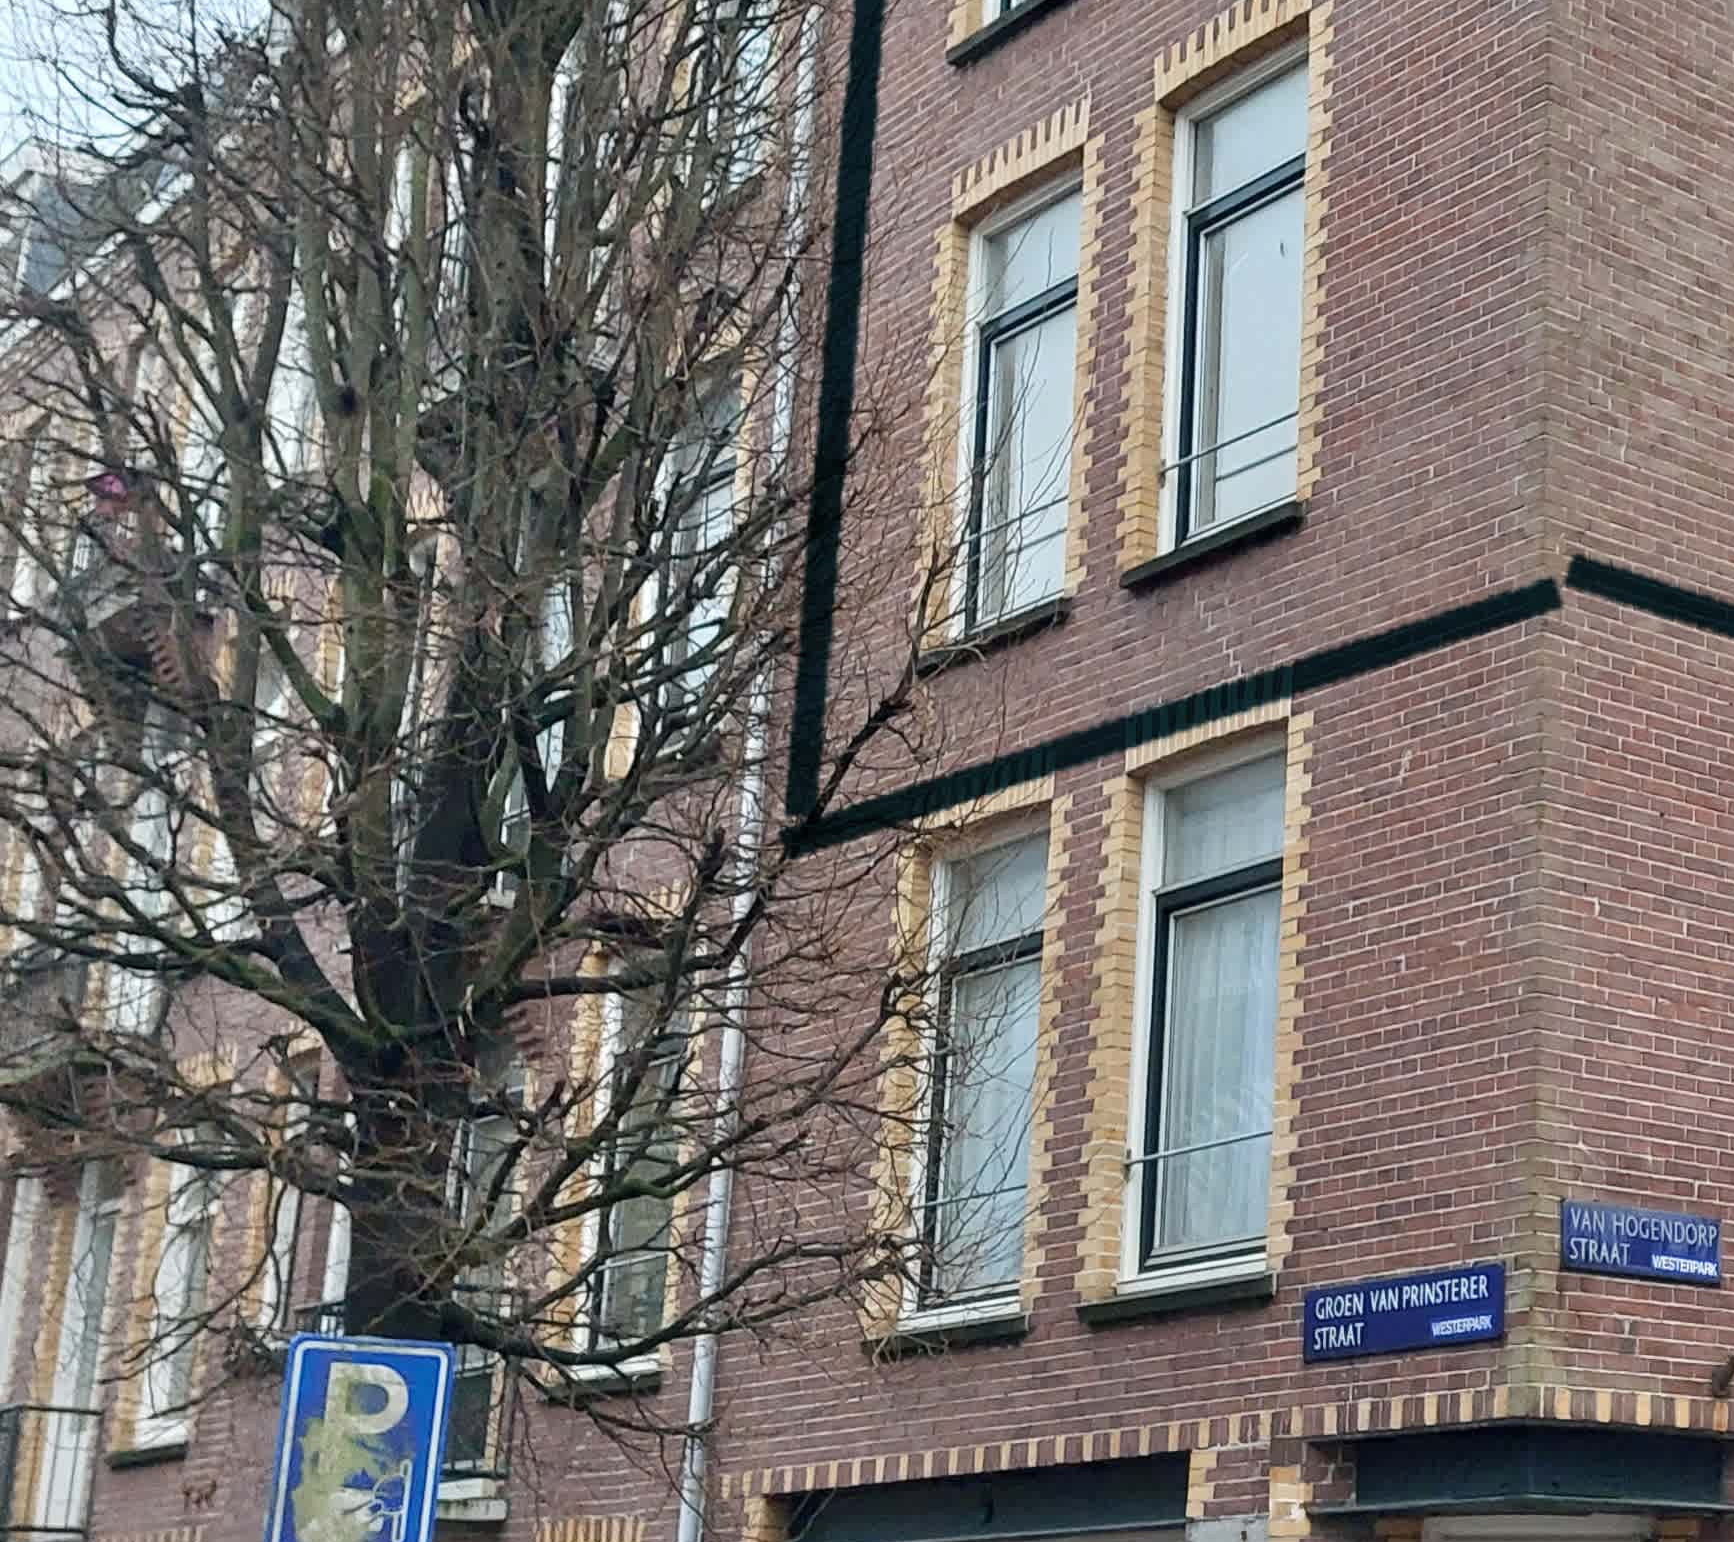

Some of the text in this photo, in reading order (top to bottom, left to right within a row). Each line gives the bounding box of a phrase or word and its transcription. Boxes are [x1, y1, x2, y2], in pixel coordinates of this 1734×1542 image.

[1570, 1207, 1717, 1247] VAN HOGENDORP
[1569, 1237, 1630, 1267] STRAAT
[1651, 1254, 1717, 1276] WESTERPARK
[1315, 1275, 1488, 1320] GROEN VAN PRINSTERER
[1313, 1322, 1364, 1350] STRAAT
[1432, 1314, 1492, 1337] WESTERPARK
